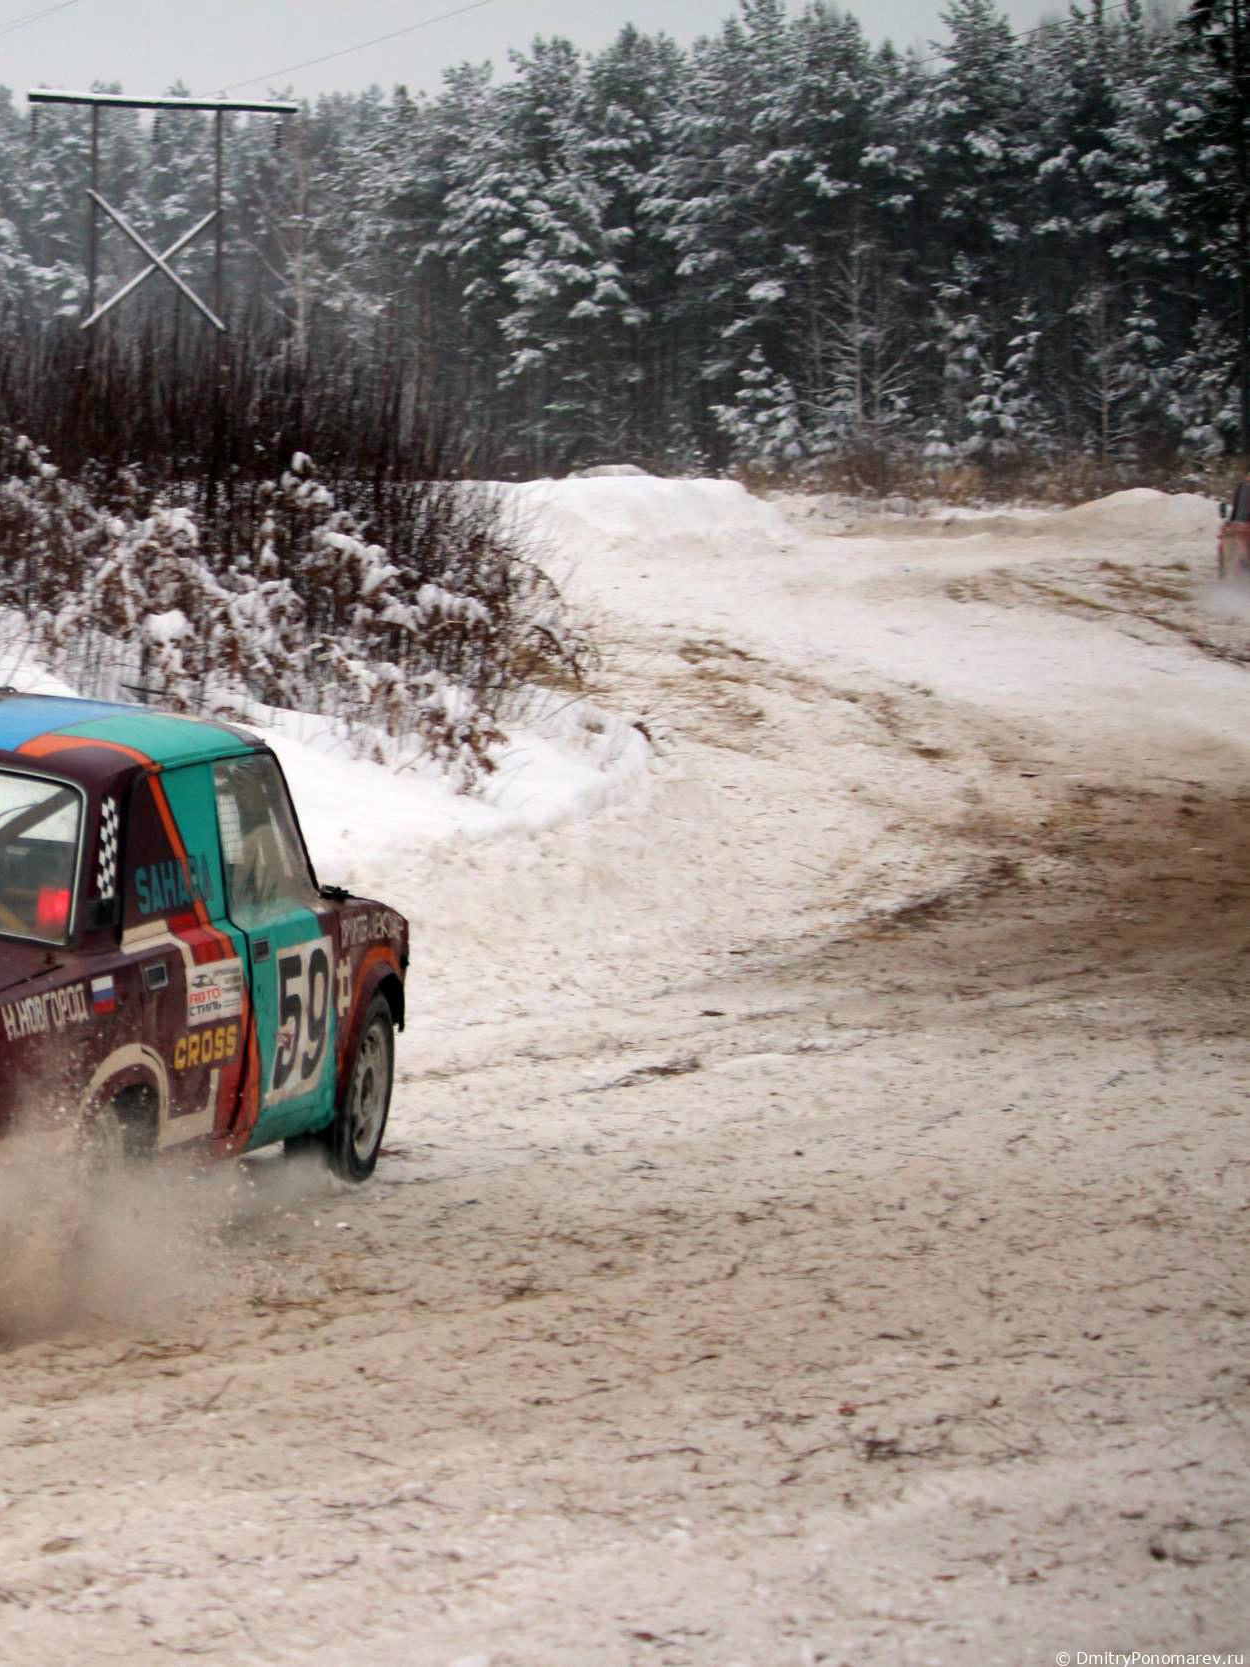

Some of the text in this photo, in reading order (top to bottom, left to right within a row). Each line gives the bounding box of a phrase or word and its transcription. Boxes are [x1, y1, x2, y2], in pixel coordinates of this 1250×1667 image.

[135, 855, 211, 914] SAHARA
[190, 988, 222, 1005] АВТО
[272, 948, 329, 1091] 59
[174, 1025, 238, 1070] CROSS
